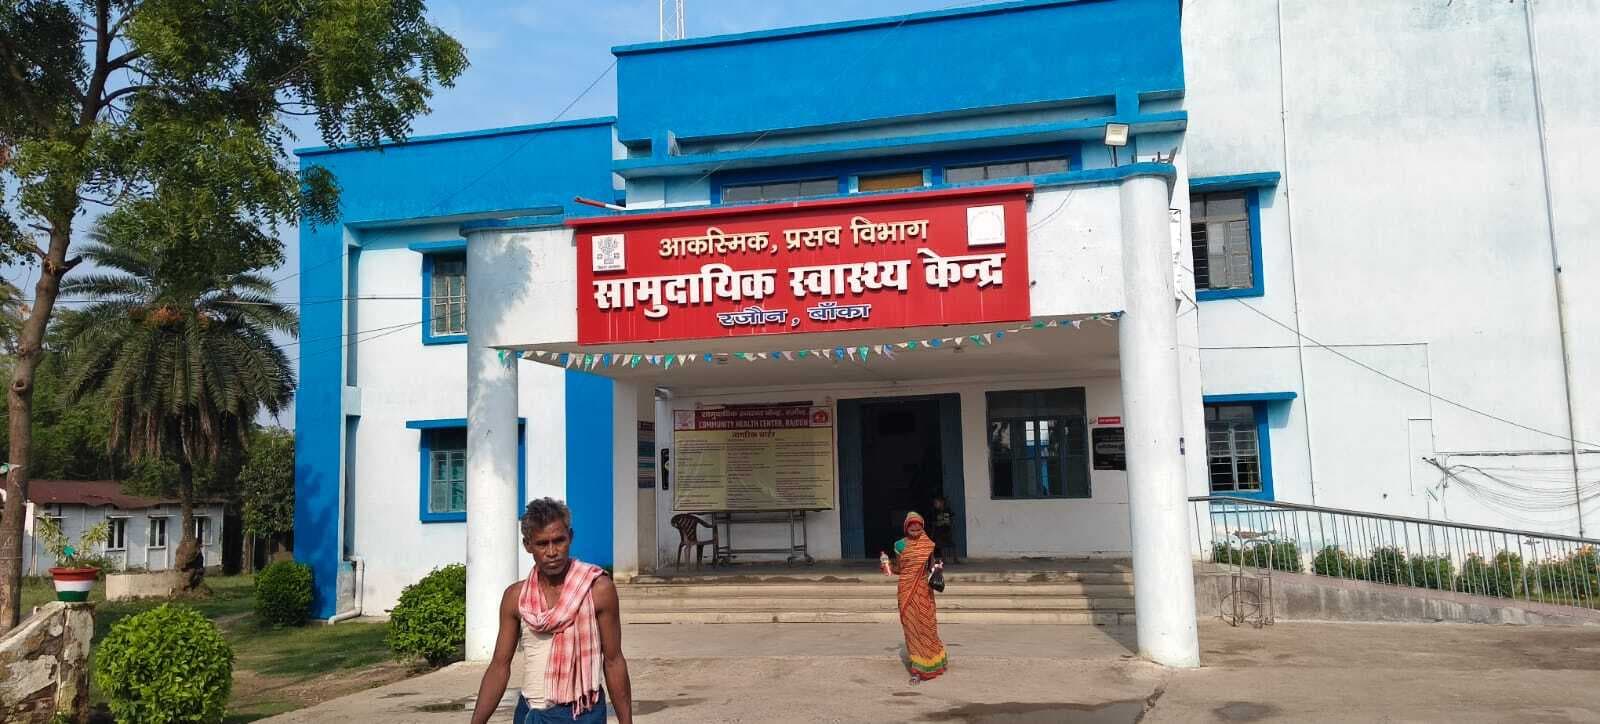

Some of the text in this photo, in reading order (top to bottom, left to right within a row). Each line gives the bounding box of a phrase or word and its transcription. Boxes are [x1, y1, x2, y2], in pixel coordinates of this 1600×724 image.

[658, 215, 929, 257] आकस्मिक, प्रसव विभाग
[593, 247, 1007, 318] सामुदायिक स्वास्थ्य केन्द्र
